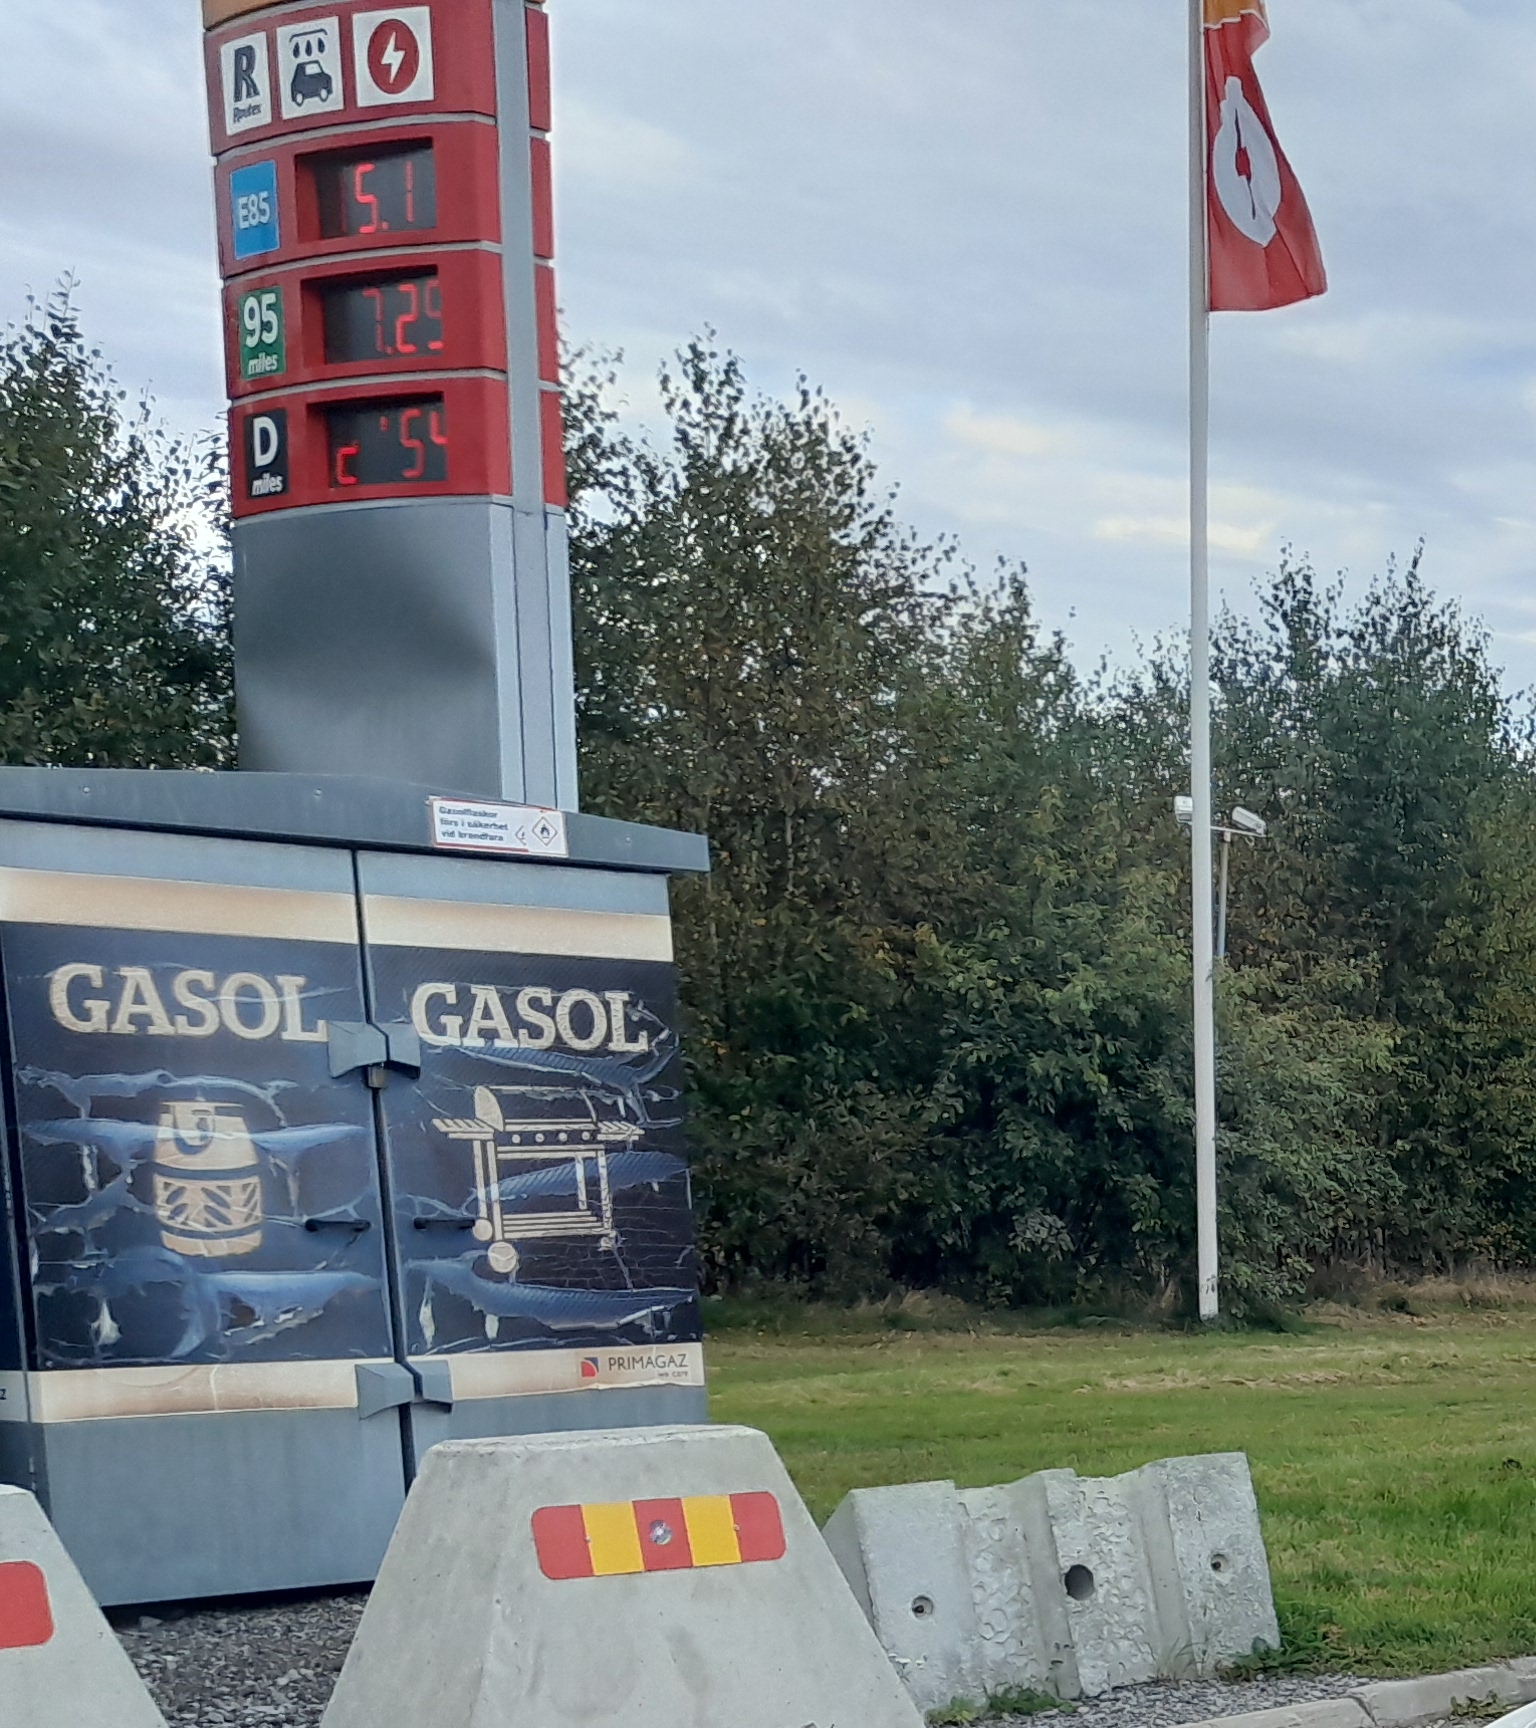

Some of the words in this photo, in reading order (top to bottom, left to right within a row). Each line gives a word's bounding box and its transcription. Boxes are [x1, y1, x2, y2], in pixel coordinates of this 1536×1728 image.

[238, 190, 271, 230] E85
[243, 292, 279, 348] 95
[252, 415, 279, 468] D
[49, 962, 329, 1042] GASOL
[411, 982, 649, 1052] GASOL
[608, 1353, 689, 1371] PRIMAGAZ
